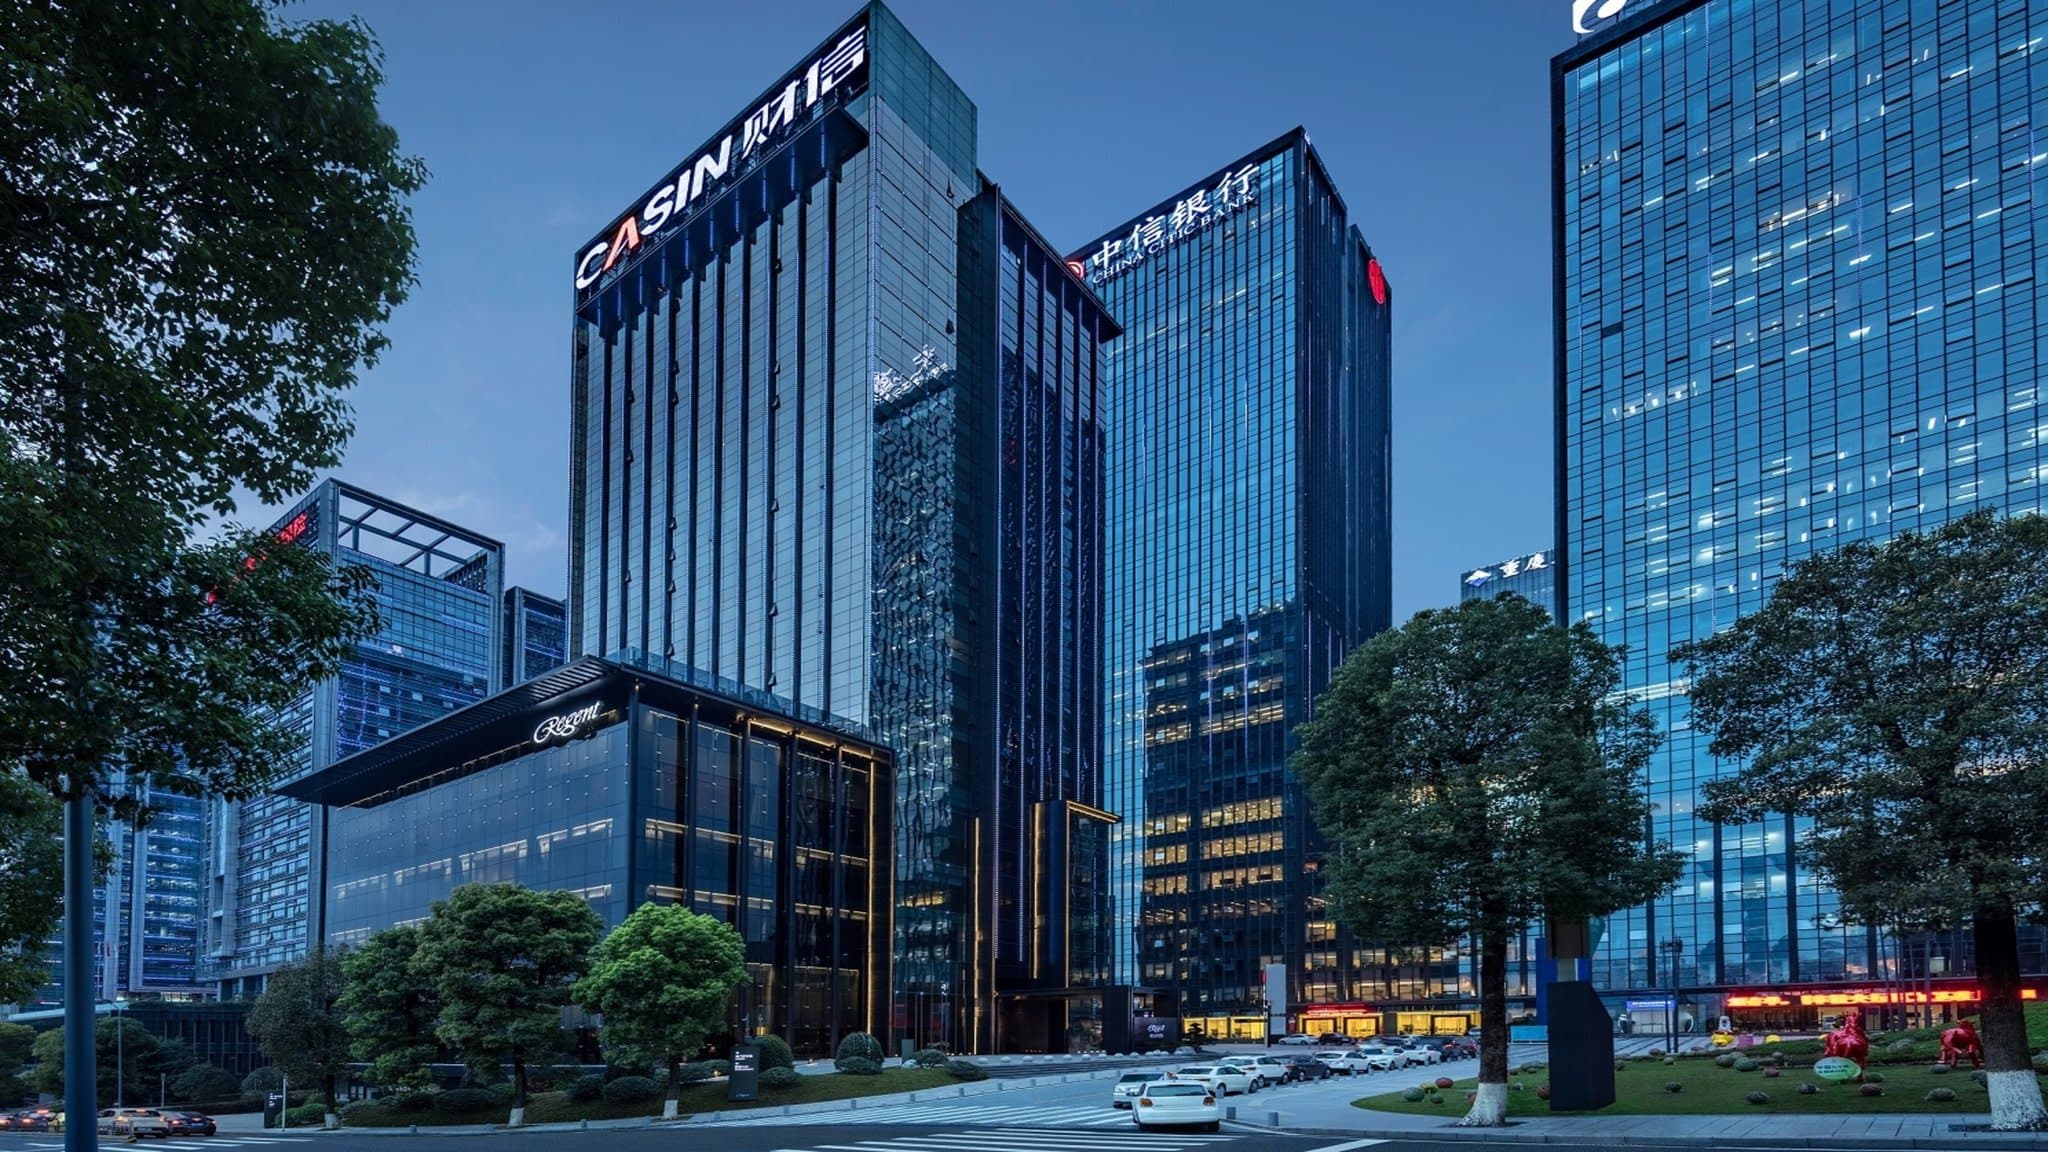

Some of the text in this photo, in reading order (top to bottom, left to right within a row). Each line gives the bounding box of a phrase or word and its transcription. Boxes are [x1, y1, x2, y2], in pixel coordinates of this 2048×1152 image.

[575, 24, 867, 290] CASIN 财信
[1092, 162, 1260, 270] 中信银行
[1092, 190, 1256, 284] CHINA CITIC BANK
[533, 700, 601, 743] Regent
